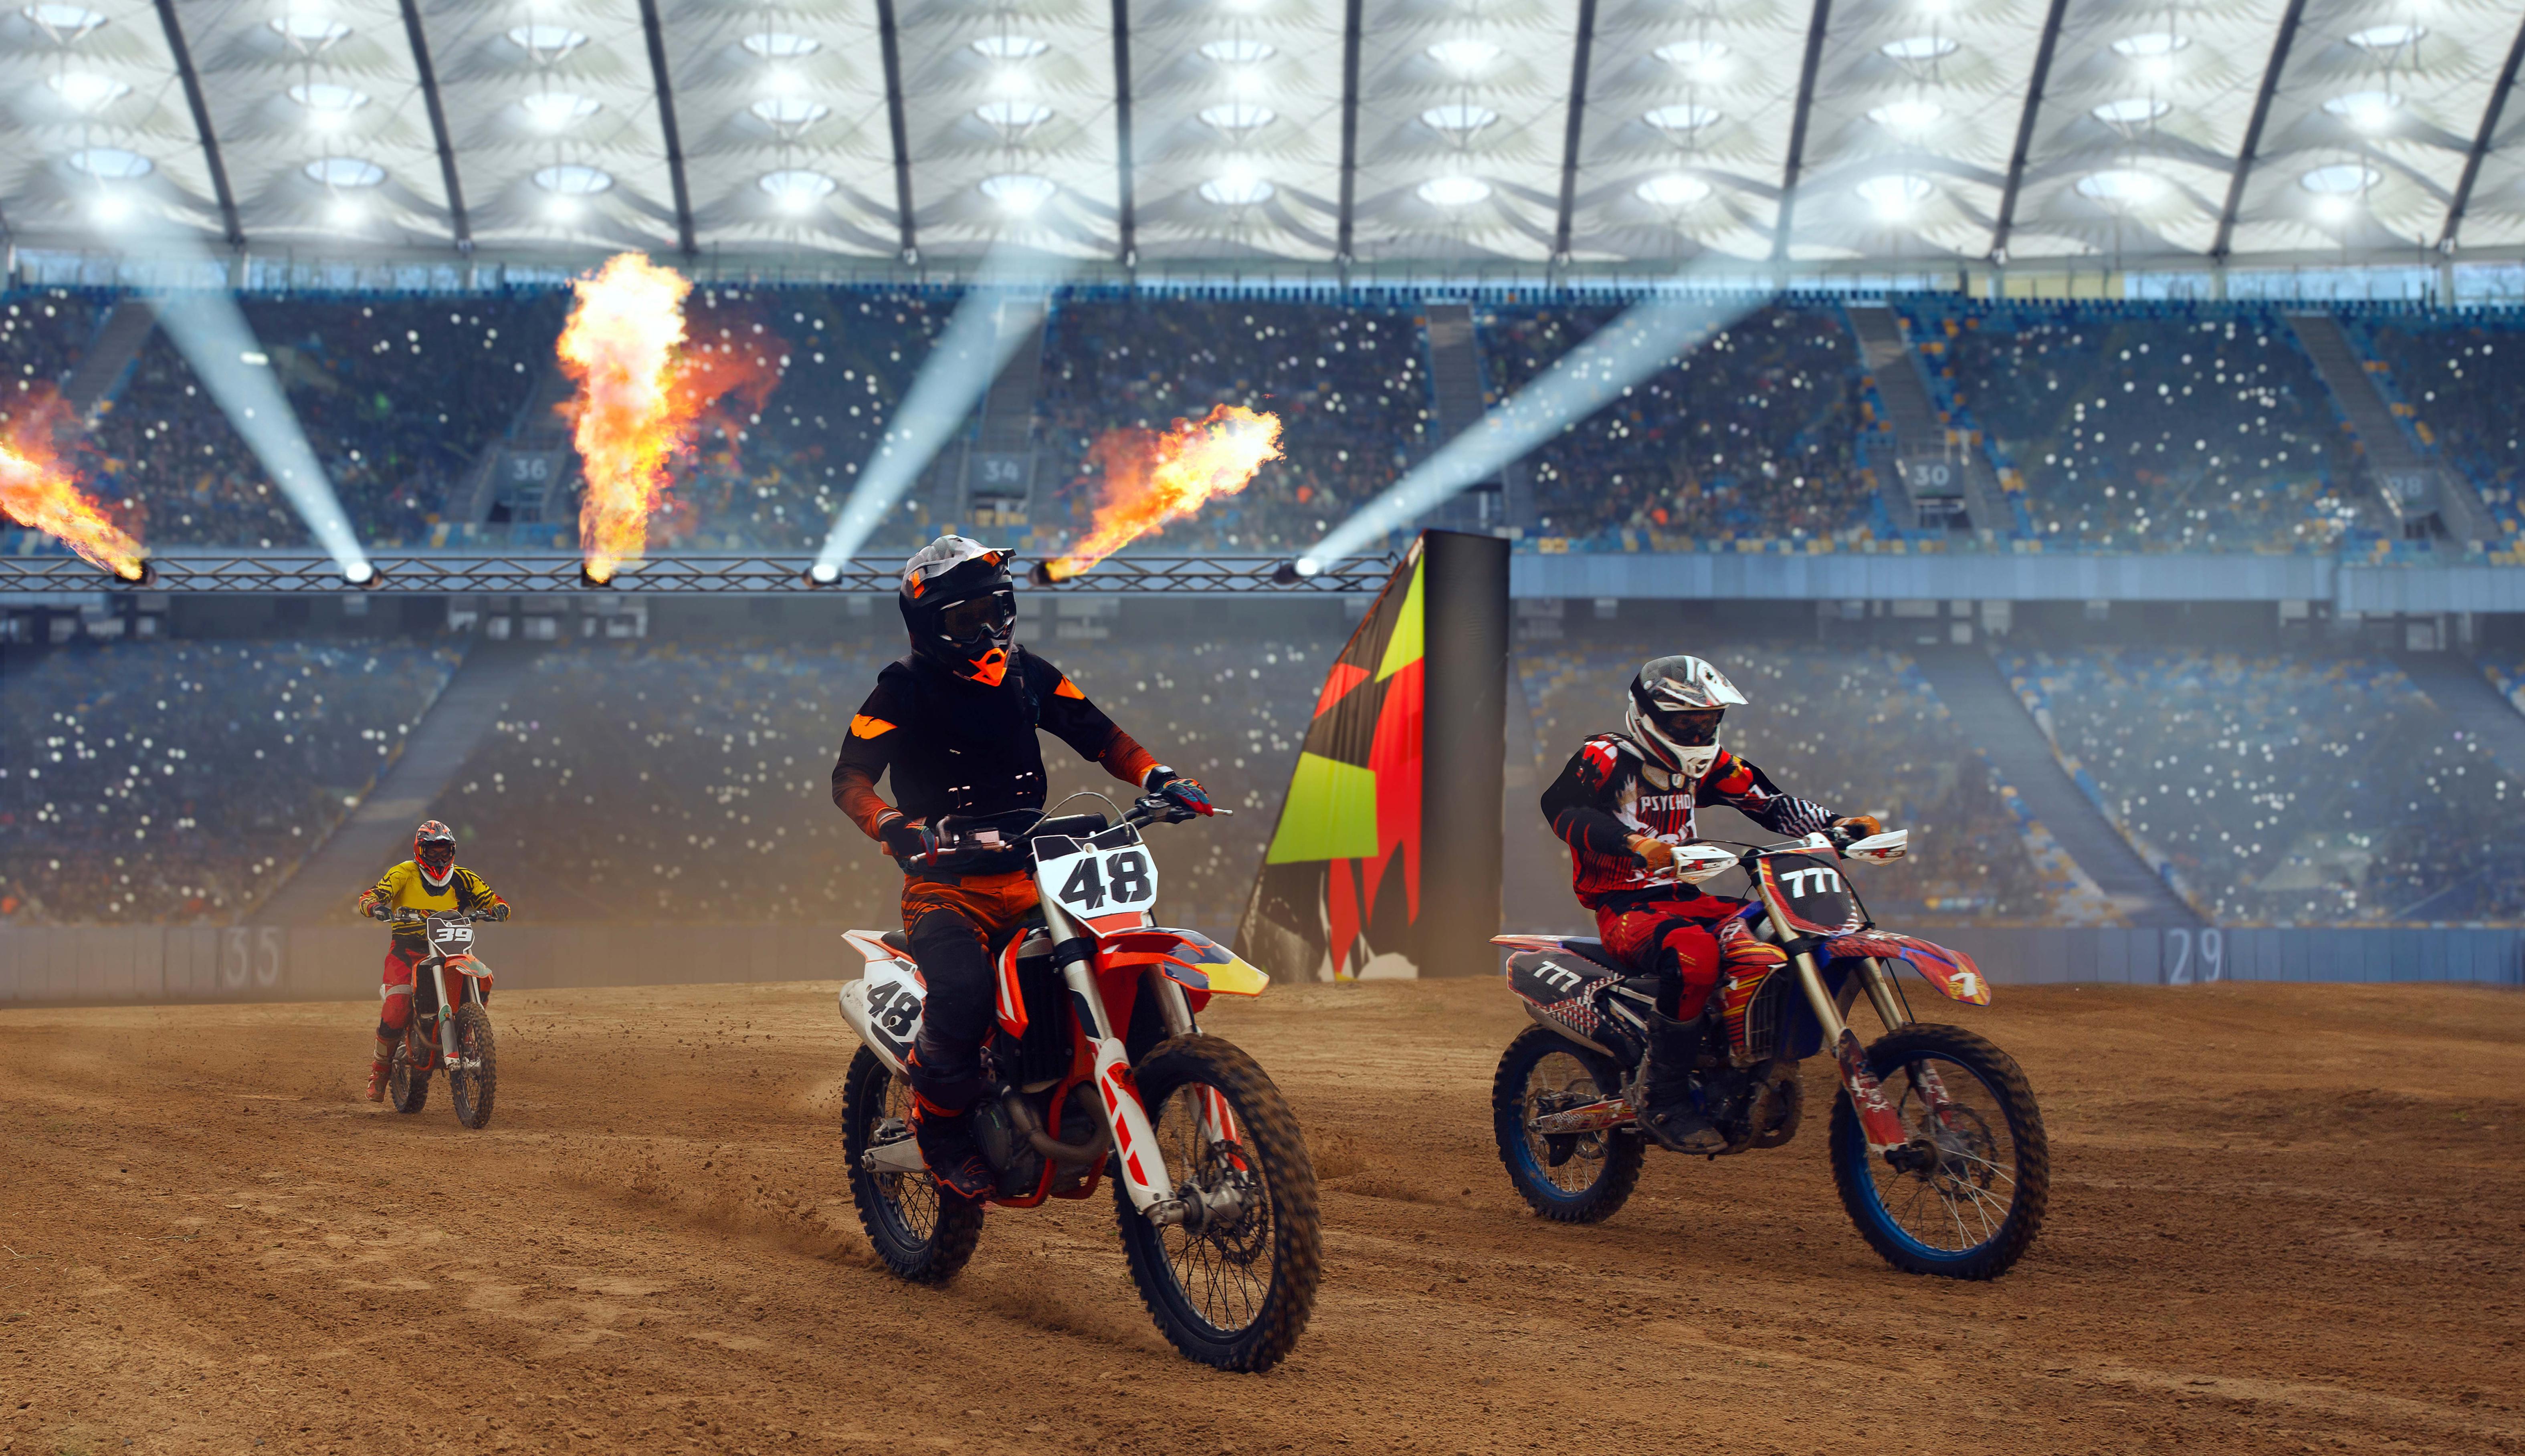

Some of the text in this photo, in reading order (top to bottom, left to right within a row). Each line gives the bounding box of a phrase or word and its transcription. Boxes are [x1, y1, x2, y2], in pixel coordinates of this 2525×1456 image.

[513, 459, 547, 480] 36
[1915, 465, 1949, 486] 30
[1640, 794, 1691, 813] PSYCHO
[1058, 851, 1152, 910] 48
[1780, 867, 1842, 898] 777
[434, 928, 473, 943] 39
[226, 927, 279, 986] 35
[2169, 928, 2222, 985] 29
[1533, 961, 1582, 993] 777
[1949, 972, 1978, 997] 7
[867, 980, 922, 1037] 48
